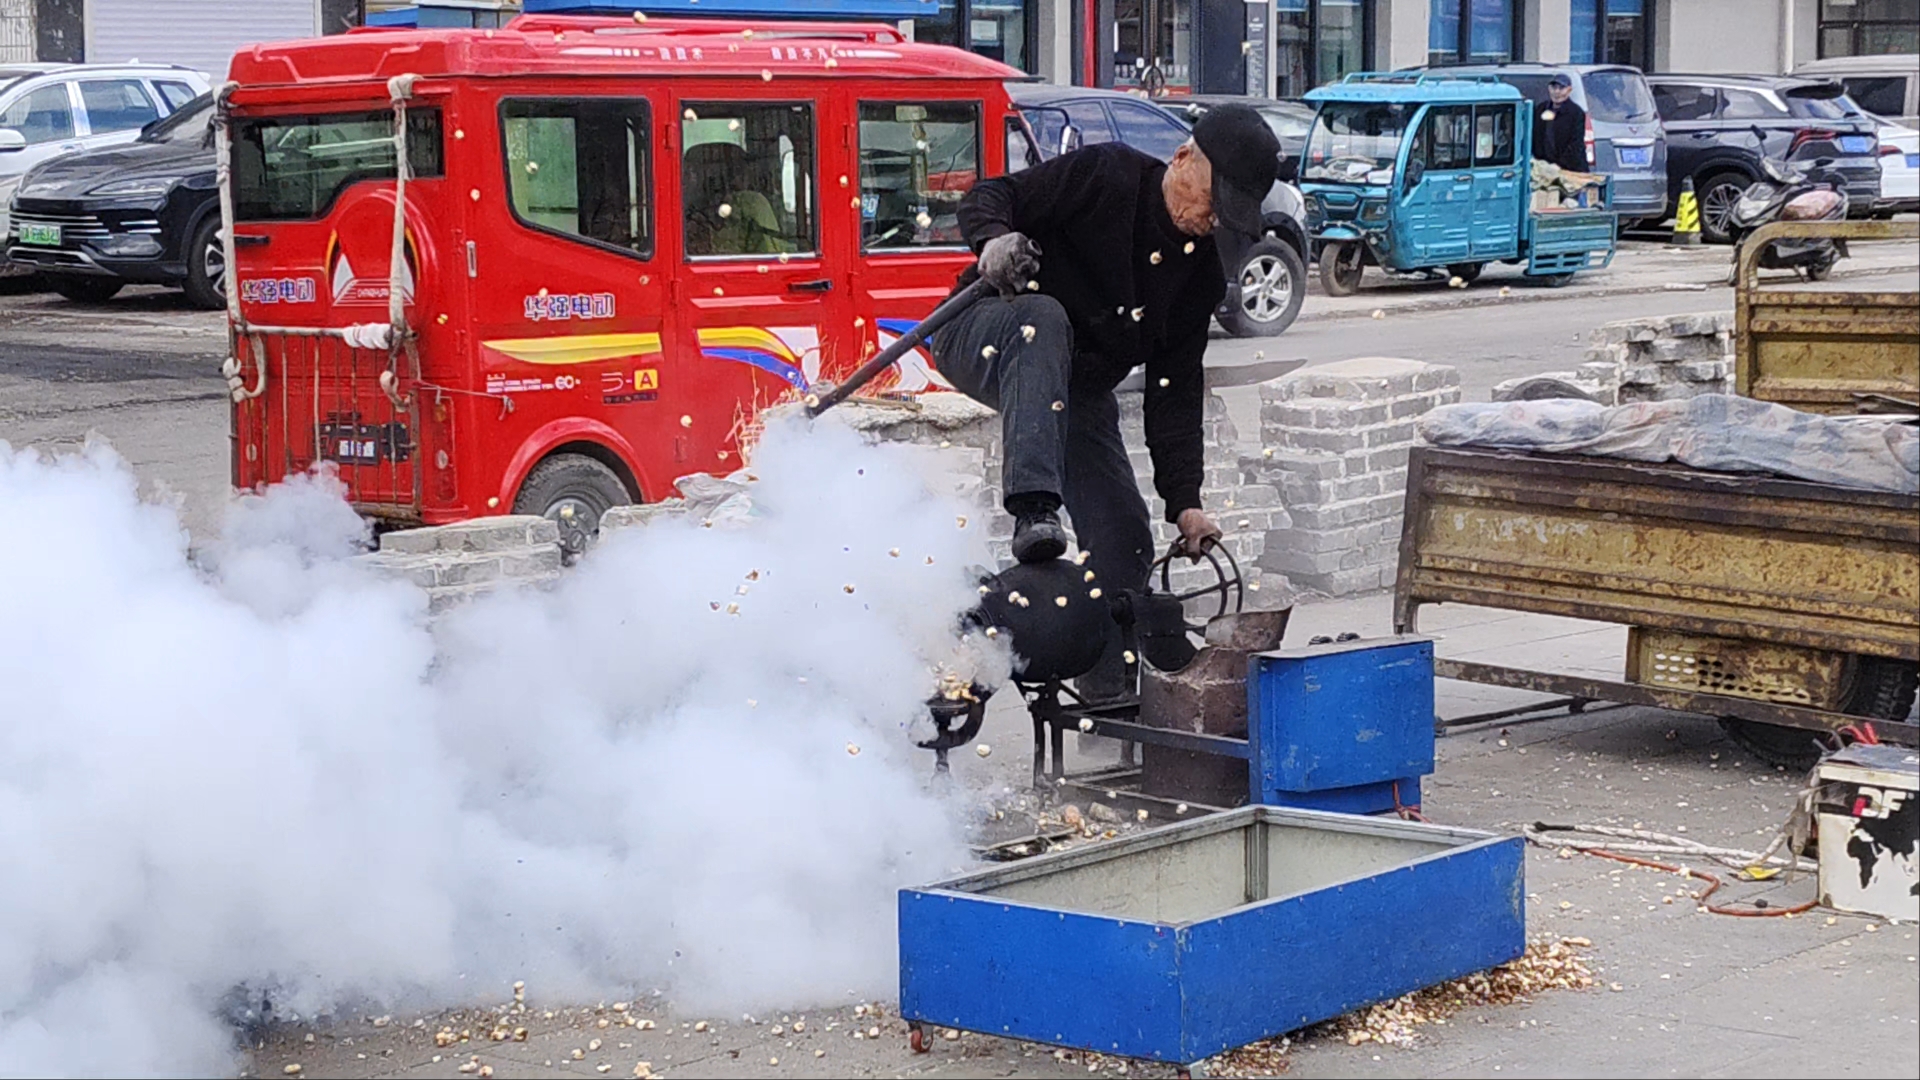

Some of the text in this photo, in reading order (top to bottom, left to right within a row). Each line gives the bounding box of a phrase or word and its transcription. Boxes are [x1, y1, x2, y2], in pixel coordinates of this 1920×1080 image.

[241, 277, 315, 303] 华强电动
[524, 293, 615, 321] 华强电动
